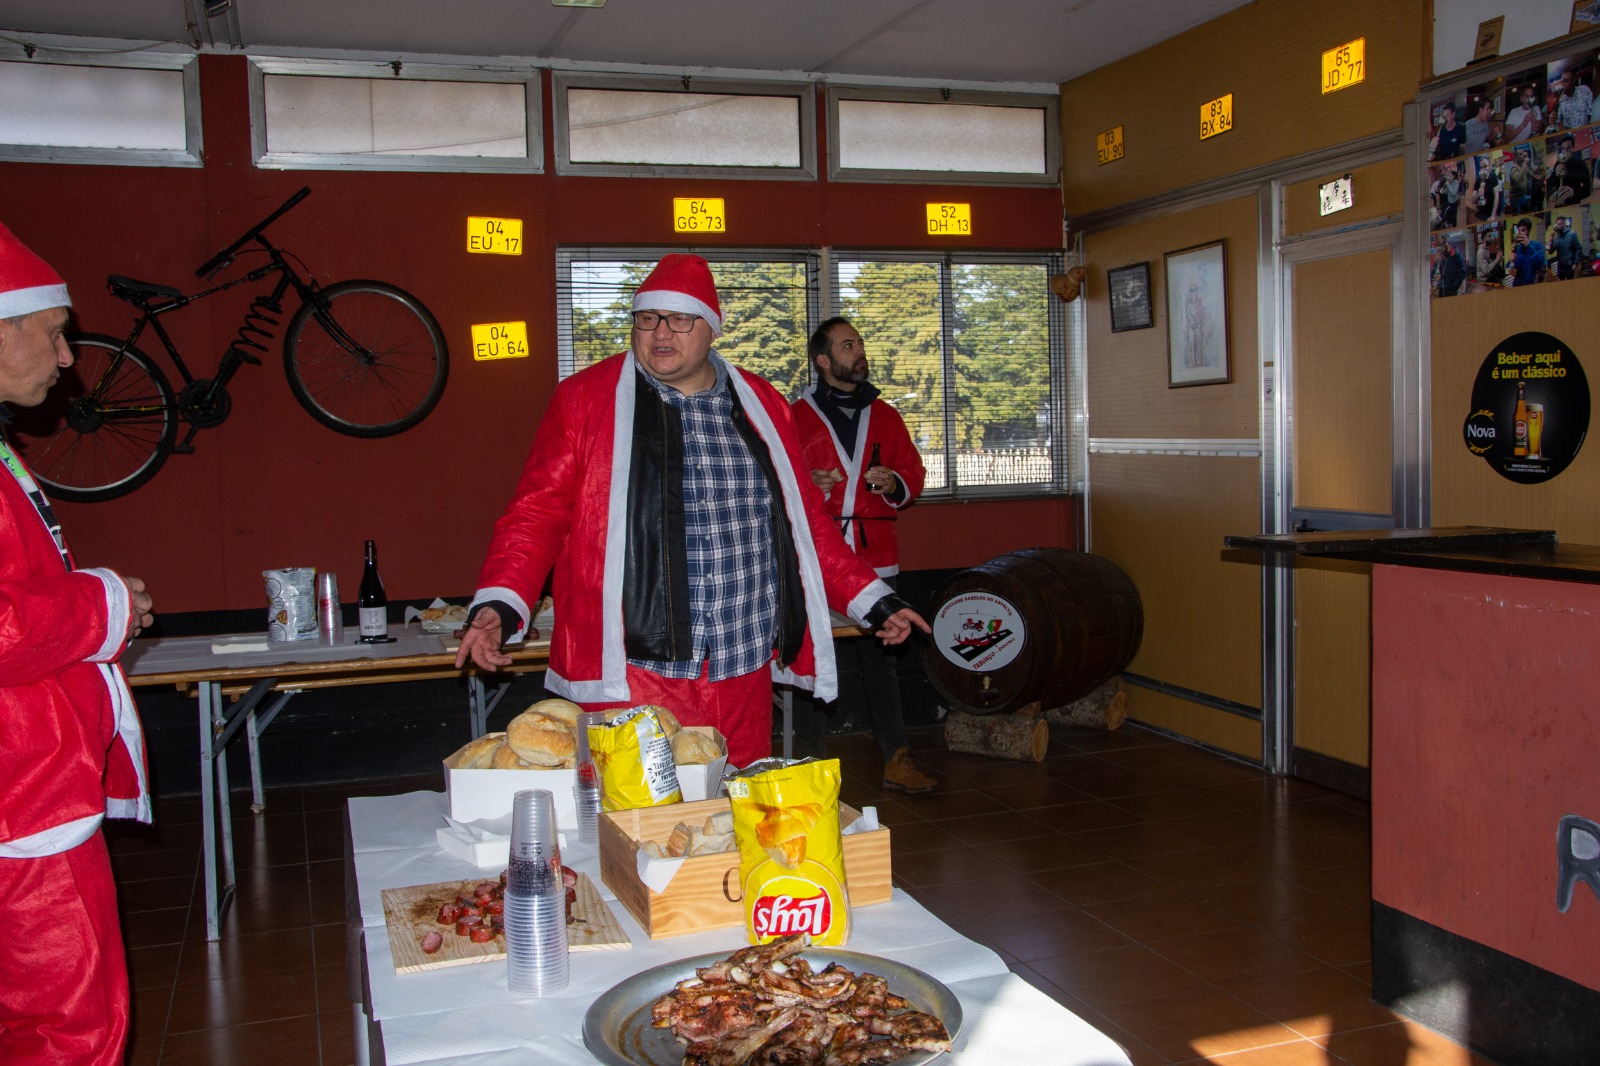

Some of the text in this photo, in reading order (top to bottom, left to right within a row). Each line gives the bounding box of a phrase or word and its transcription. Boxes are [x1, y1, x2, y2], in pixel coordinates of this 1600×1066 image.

[1336, 46, 1350, 67] 65
[1210, 100, 1223, 117] 83
[690, 201, 708, 214] 64
[941, 205, 956, 218] 52
[486, 220, 504, 235] 04
[490, 326, 508, 340] 04
[1497, 350, 1561, 366] Beber aqui
[1491, 365, 1567, 379] é um clássico
[1467, 424, 1496, 438] Nova
[941, 597, 964, 618] MOTOCLUBE
[972, 651, 996, 670] TABUAÇO
[756, 895, 825, 938] Lay's
